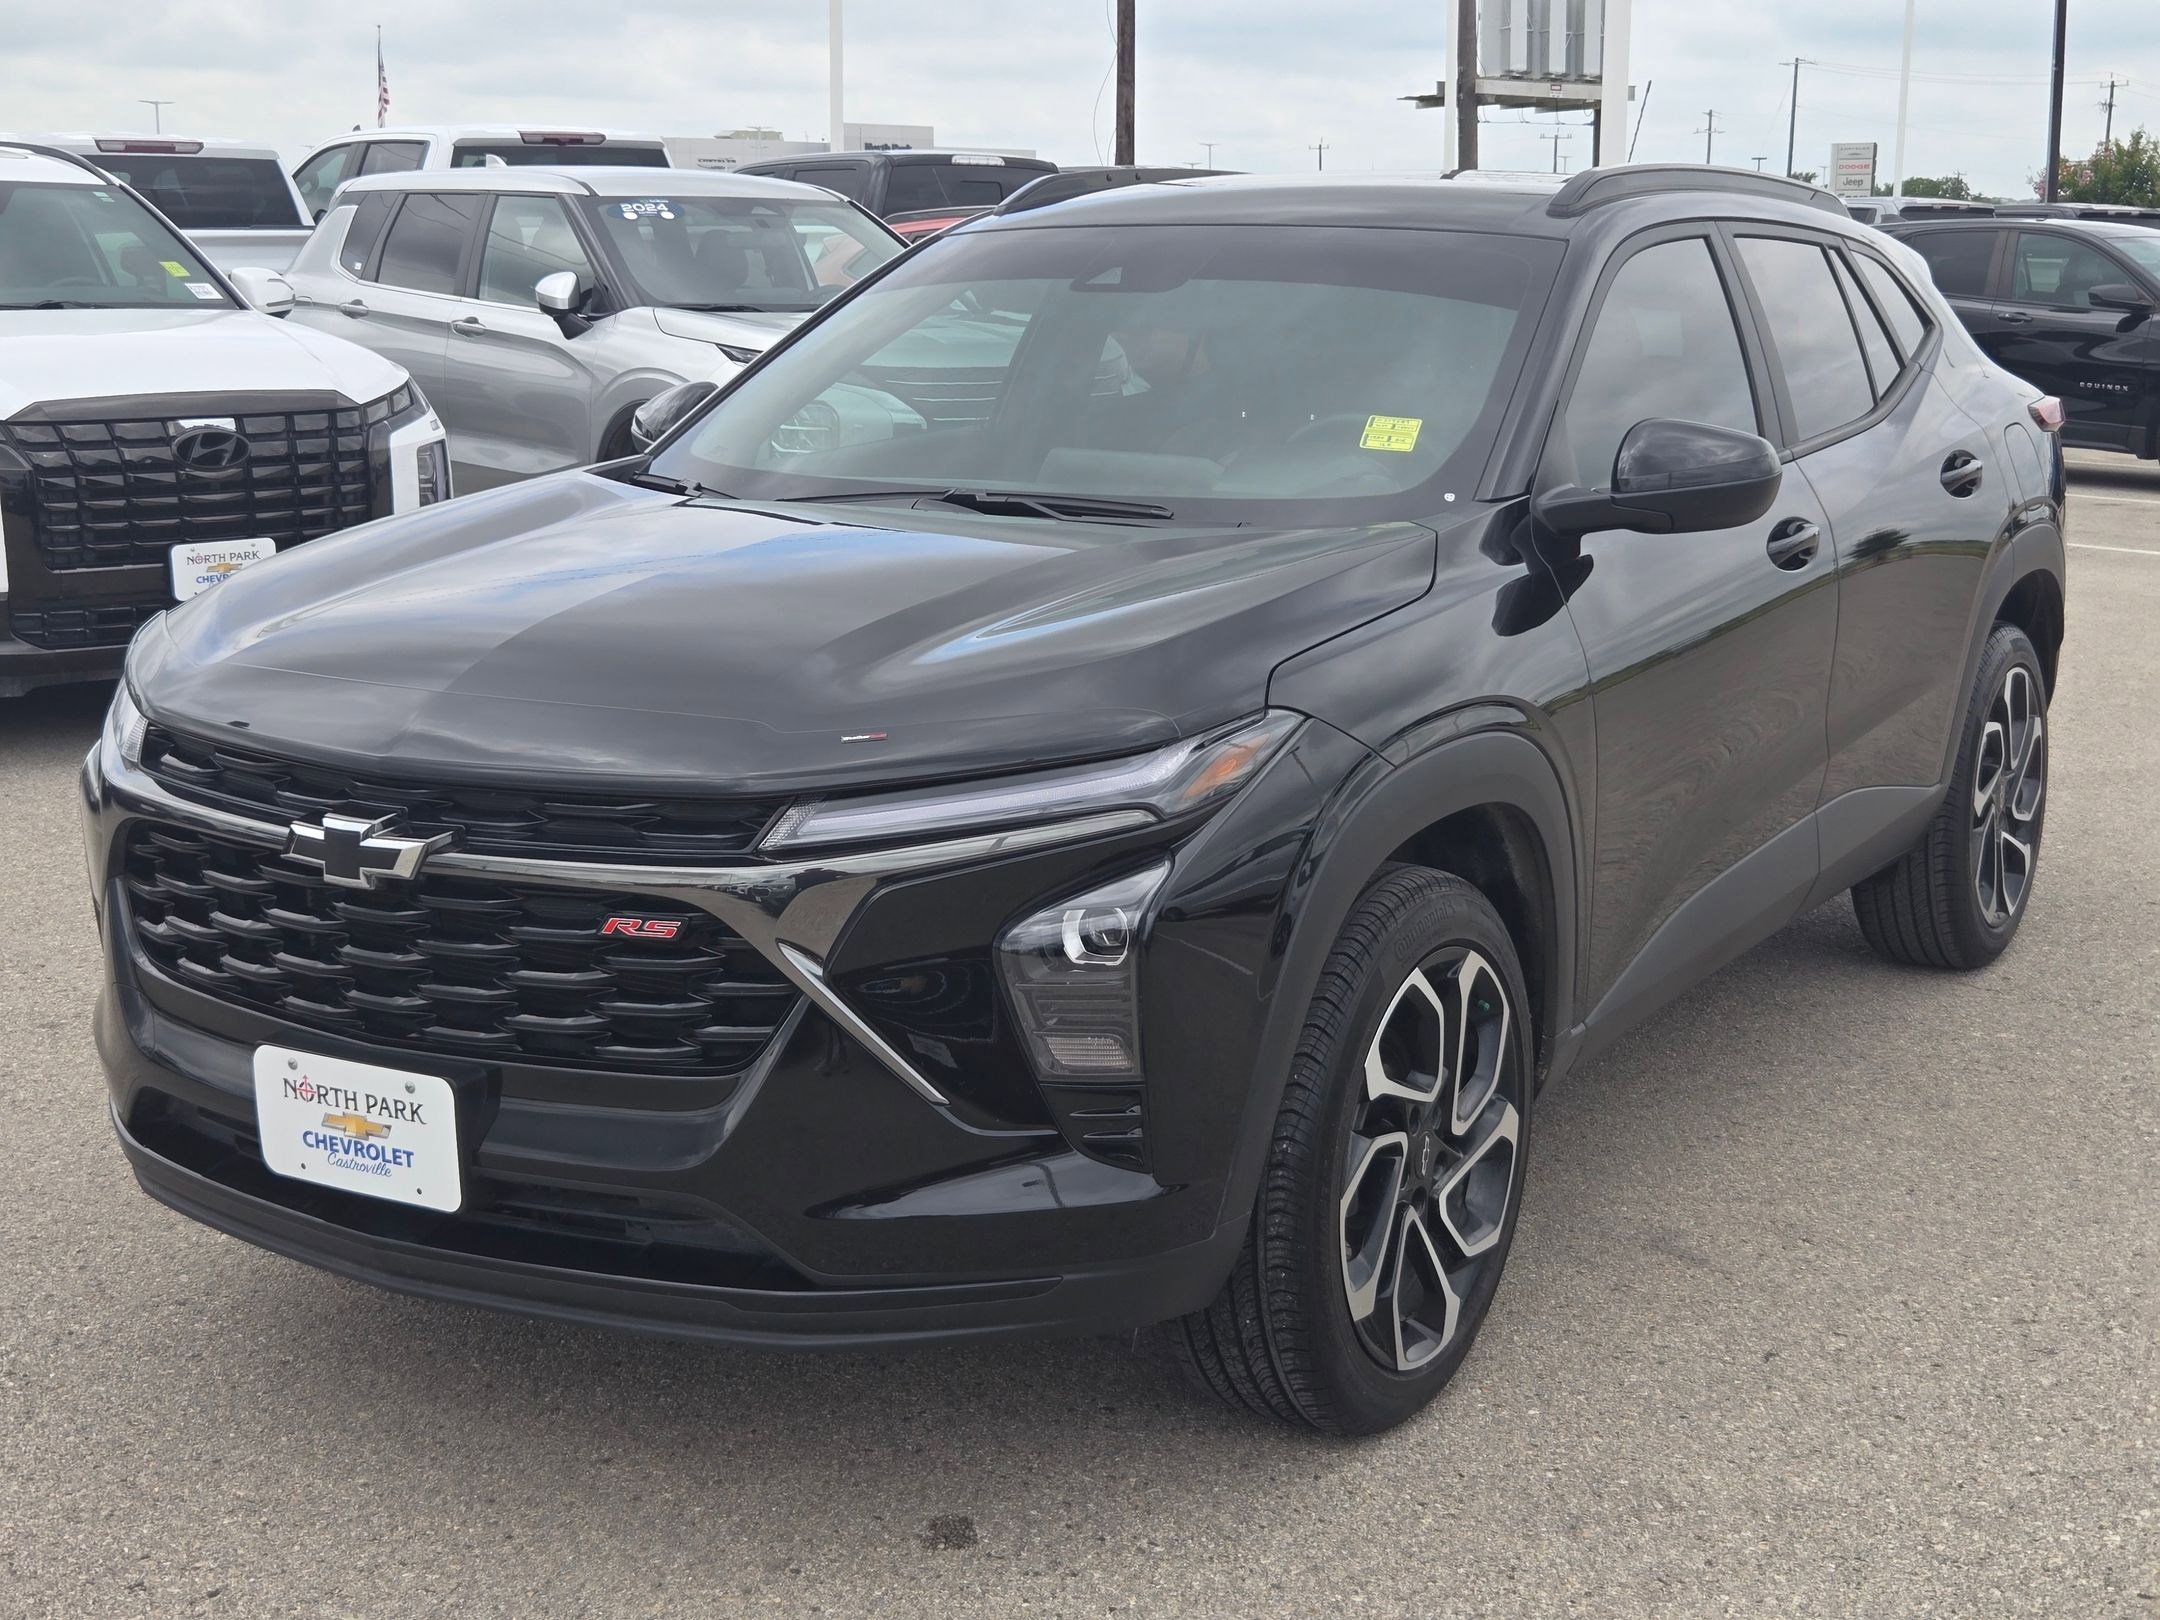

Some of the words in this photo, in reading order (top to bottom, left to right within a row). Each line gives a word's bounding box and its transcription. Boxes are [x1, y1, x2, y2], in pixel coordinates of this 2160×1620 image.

[1843, 177, 1863, 188] Jeep
[620, 203, 668, 212] 2024
[2079, 381, 2129, 392] EQUINOX
[186, 553, 225, 565] NORTH
[229, 550, 260, 561] PARK
[601, 917, 682, 939] RS
[283, 1074, 359, 1112] NORTH
[365, 1093, 427, 1125] PARK
[302, 1130, 415, 1168] CHEVROLET
[327, 1151, 393, 1178] Castroville
